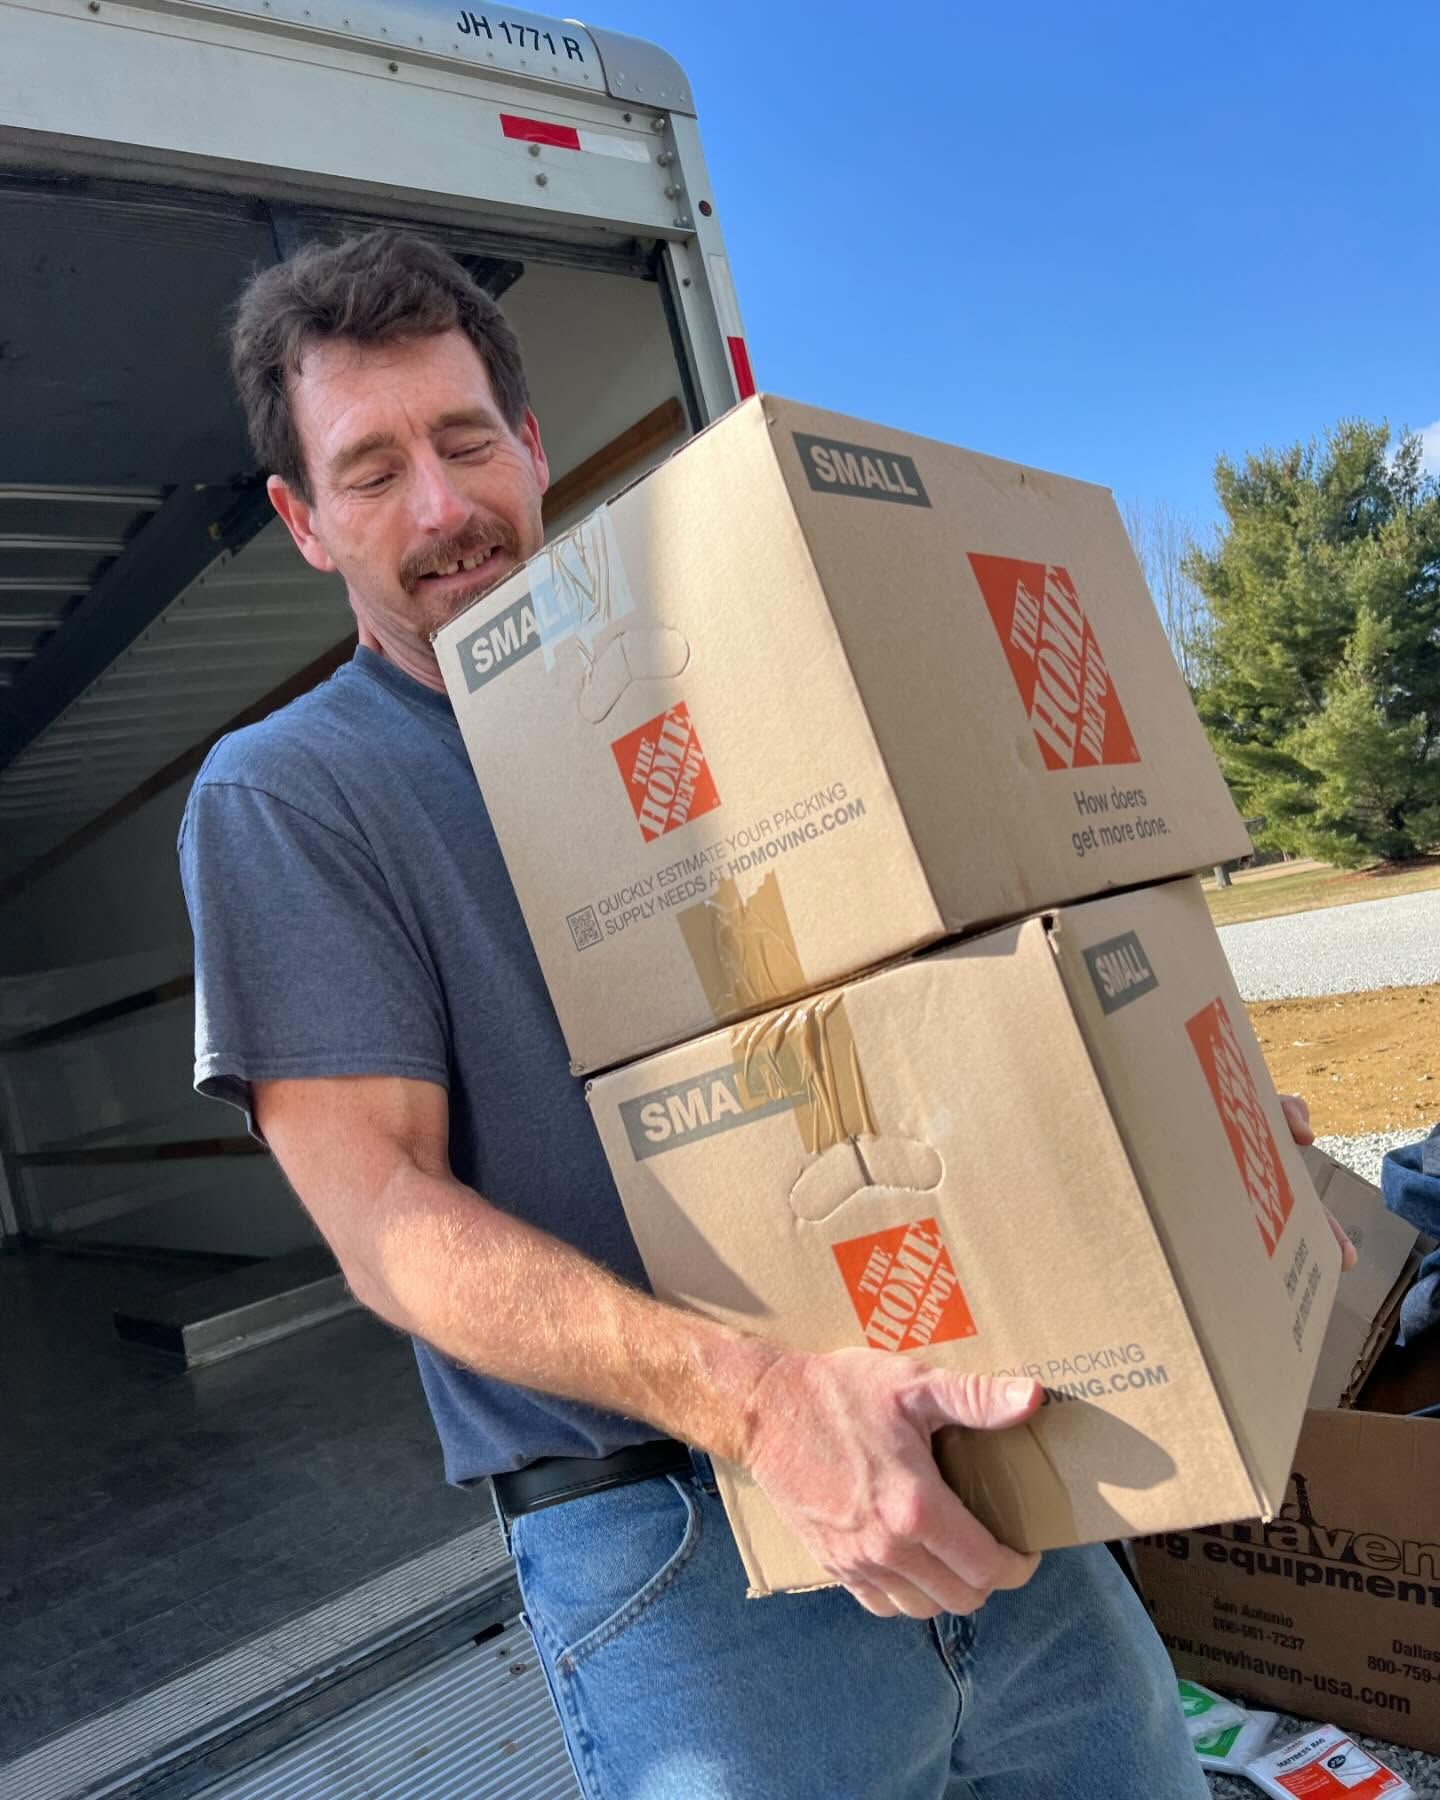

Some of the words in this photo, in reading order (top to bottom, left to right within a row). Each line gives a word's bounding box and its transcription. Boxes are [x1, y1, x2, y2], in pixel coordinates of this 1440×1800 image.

[457, 10, 493, 39] JH
[498, 21, 556, 55] 1771
[562, 36, 584, 62] R
[810, 445, 919, 496] SMALL
[632, 737, 656, 785] THE
[639, 709, 692, 836] HOME
[1073, 790, 1108, 816] How
[1111, 786, 1148, 809] doers
[600, 873, 656, 916] QUICKLY
[657, 845, 727, 886] ESTIMATE
[726, 819, 773, 855] YOUR
[775, 782, 847, 831] PACKING
[1072, 825, 1098, 857] get
[1099, 822, 1134, 846] more
[1135, 816, 1171, 838] done.
[605, 899, 658, 936] SUPPLY
[658, 877, 707, 910] NEEDS
[708, 866, 727, 888] AT
[728, 798, 866, 874] HDMOVING.COM
[1095, 944, 1150, 997] SMALL
[857, 1245, 893, 1296] THE
[866, 1222, 944, 1352] HOME
[909, 1263, 959, 1346] DEPOT
[1047, 1343, 1145, 1378] PACKING
[1367, 1656, 1440, 1684] 800-759-
[1392, 1640, 1440, 1663] Dallas
